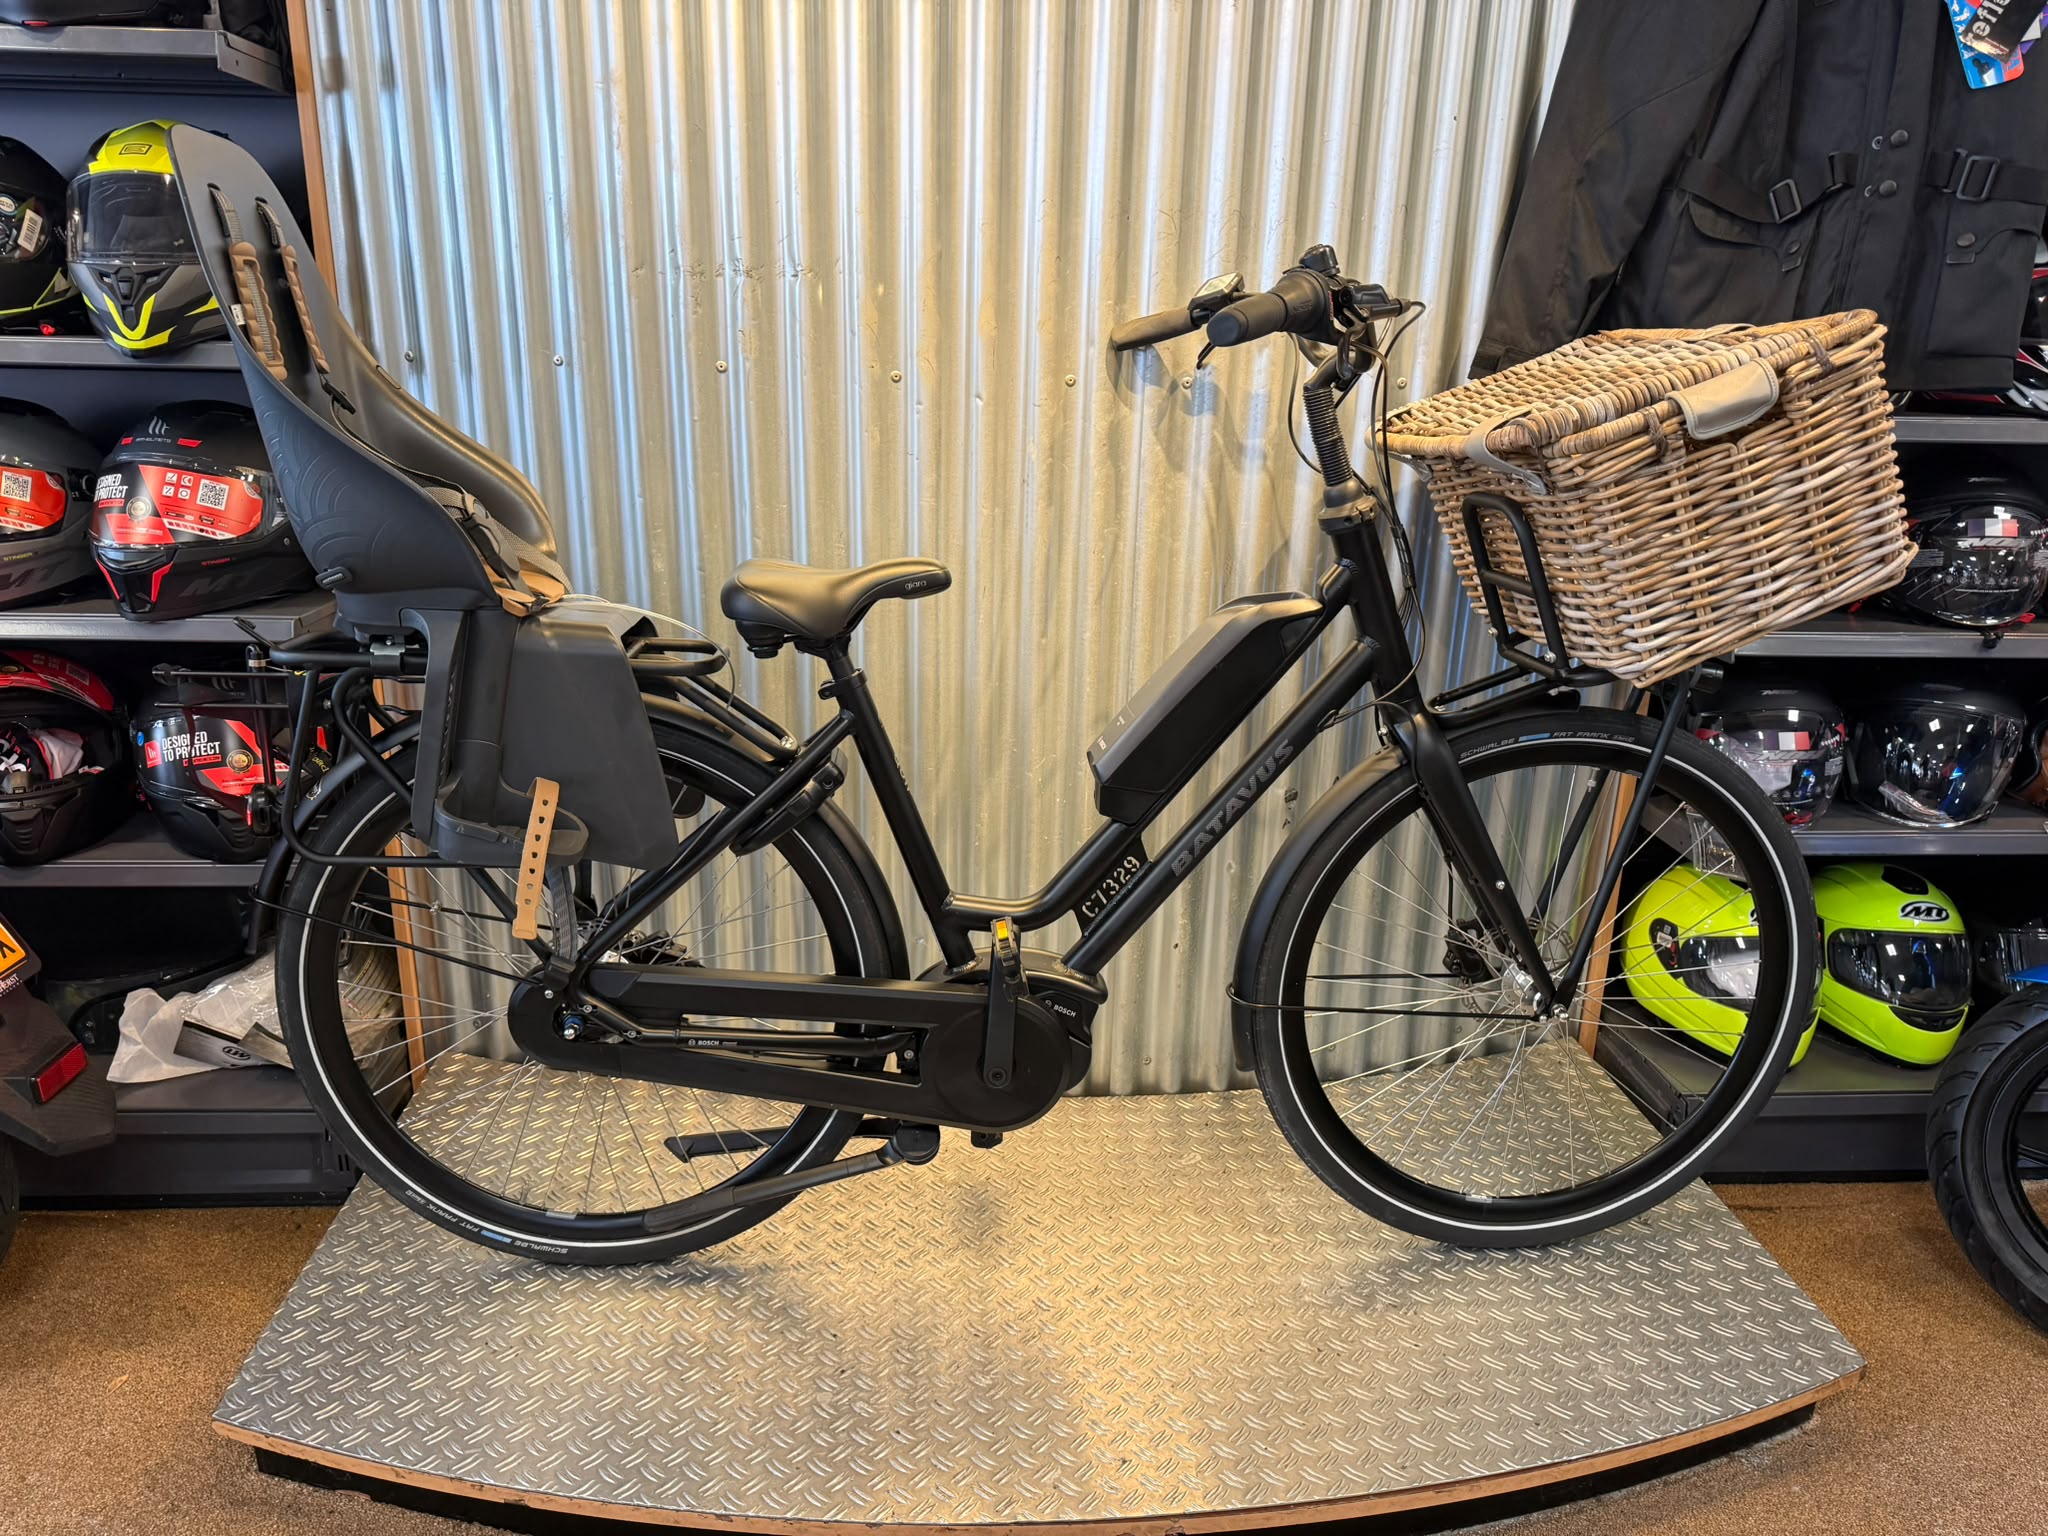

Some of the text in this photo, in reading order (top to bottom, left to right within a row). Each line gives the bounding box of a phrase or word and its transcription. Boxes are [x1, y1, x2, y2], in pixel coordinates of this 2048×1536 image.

[1460, 737, 1516, 759] SCHWALBE
[1171, 739, 1294, 877] BATAVUS
[1053, 1004, 1077, 1018] BOSCH
[513, 1240, 568, 1254] SCHWALBE
